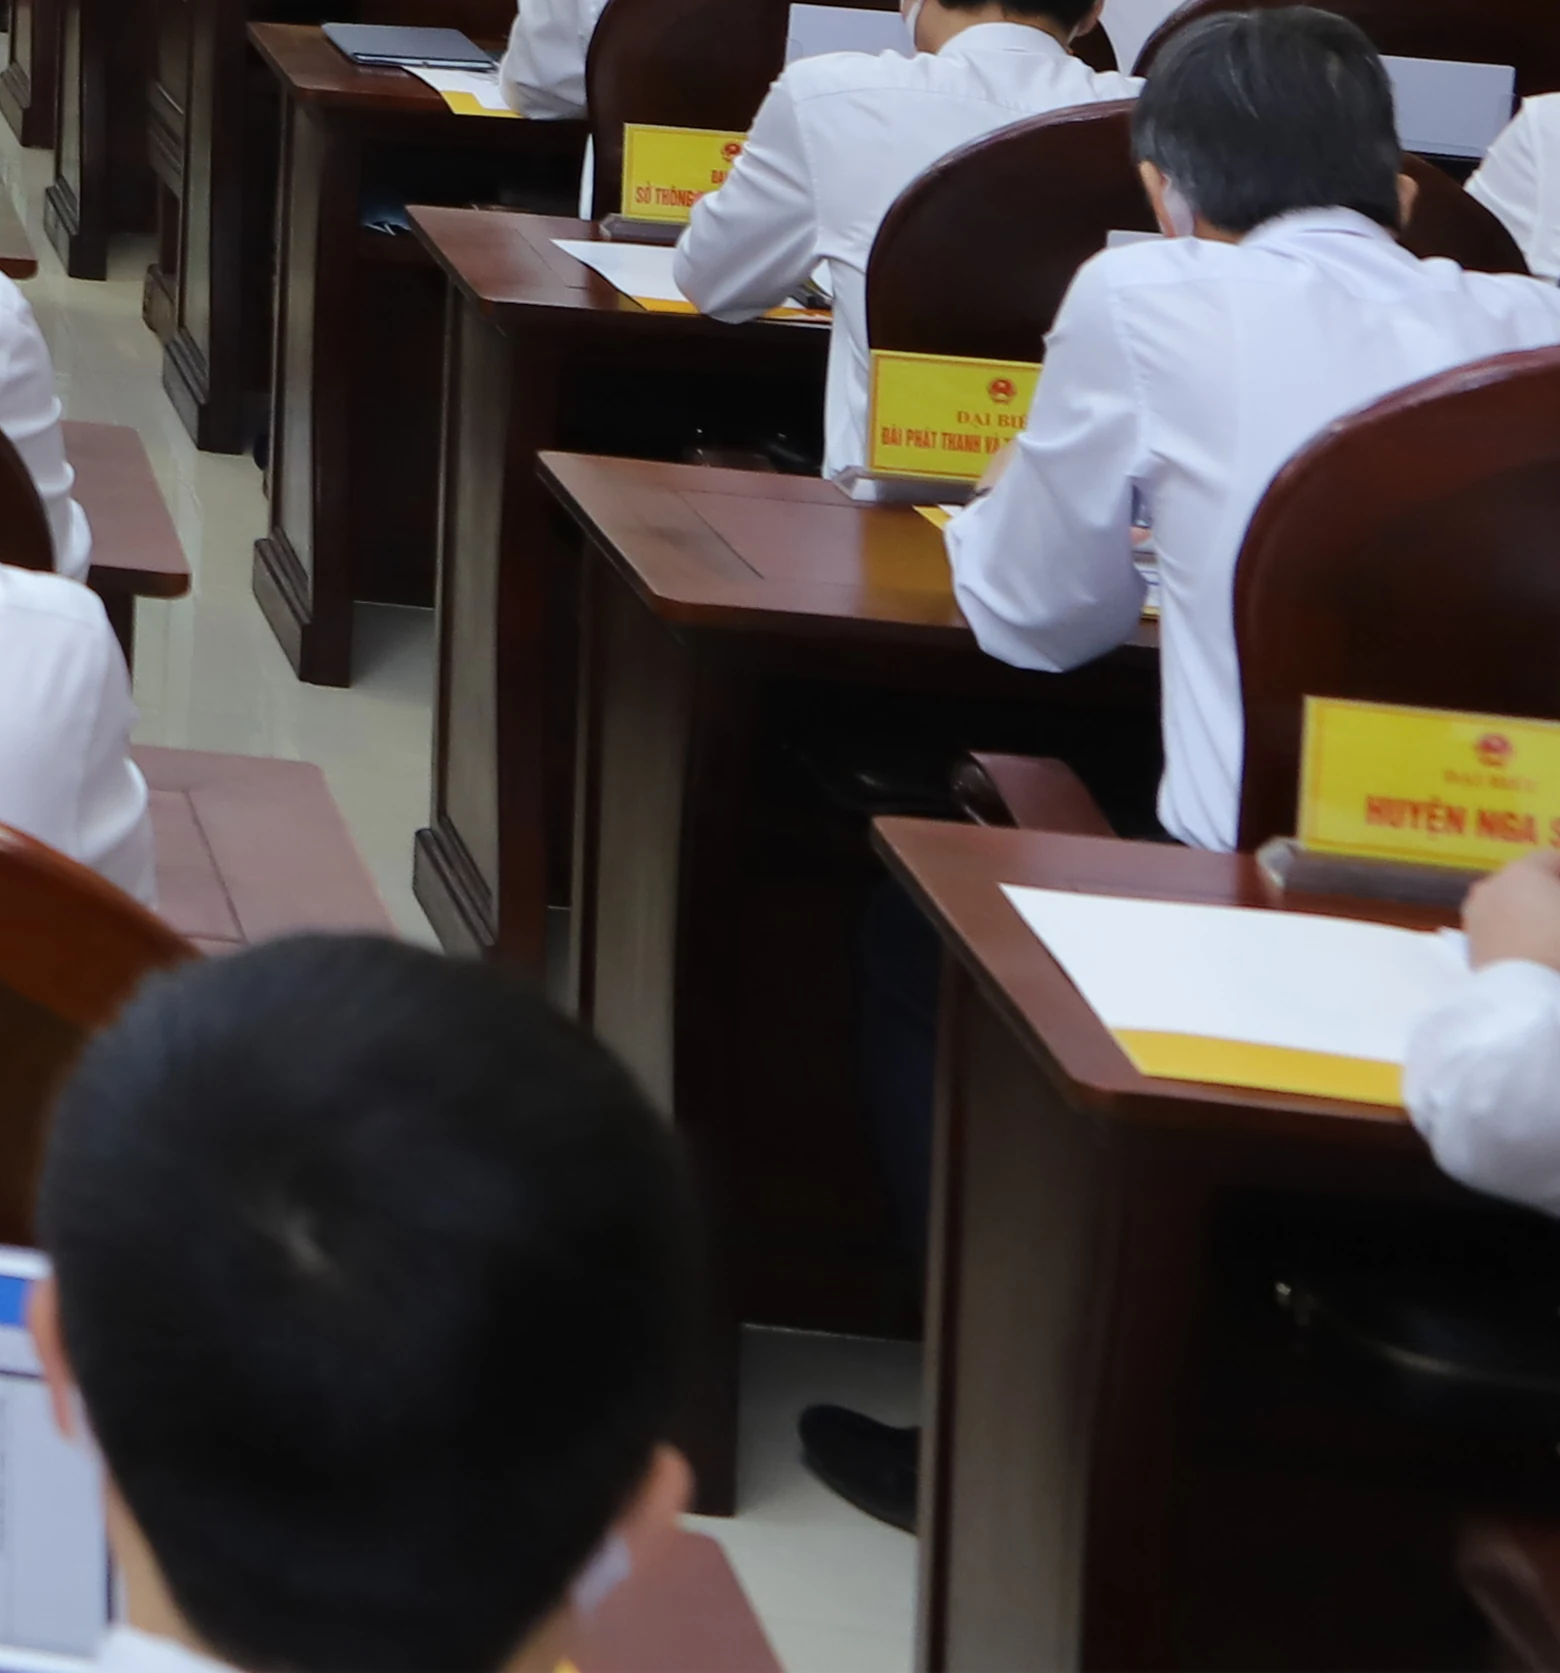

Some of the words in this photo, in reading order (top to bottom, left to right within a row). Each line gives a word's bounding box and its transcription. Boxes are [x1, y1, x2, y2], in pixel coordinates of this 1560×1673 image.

[957, 410, 991, 429] ĐẠI
[941, 430, 981, 454] THANH
[1476, 808, 1538, 846] NGA
